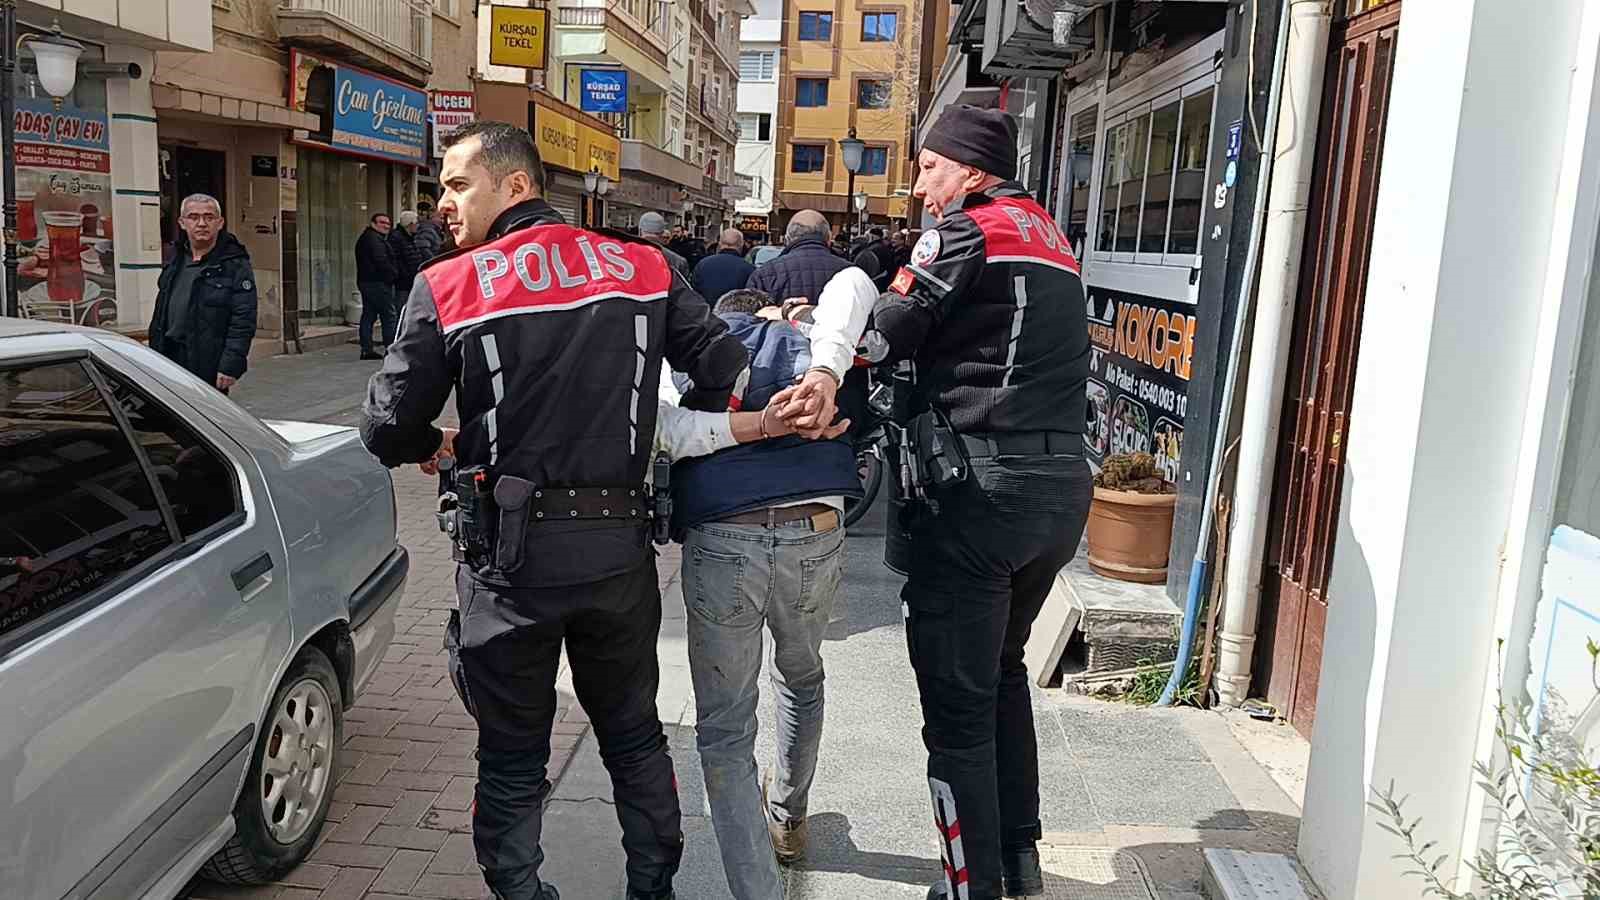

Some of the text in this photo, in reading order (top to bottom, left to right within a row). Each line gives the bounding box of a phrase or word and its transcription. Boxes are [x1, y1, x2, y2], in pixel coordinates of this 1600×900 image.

[504, 36, 533, 49] TEKEL
[337, 79, 423, 130] Can Gözleme
[591, 91, 617, 100] TEKEL
[55, 115, 81, 142] ÇAY
[472, 236, 636, 299] POLİS
[1139, 379, 1159, 405] 0540
[1158, 387, 1176, 412] 003
